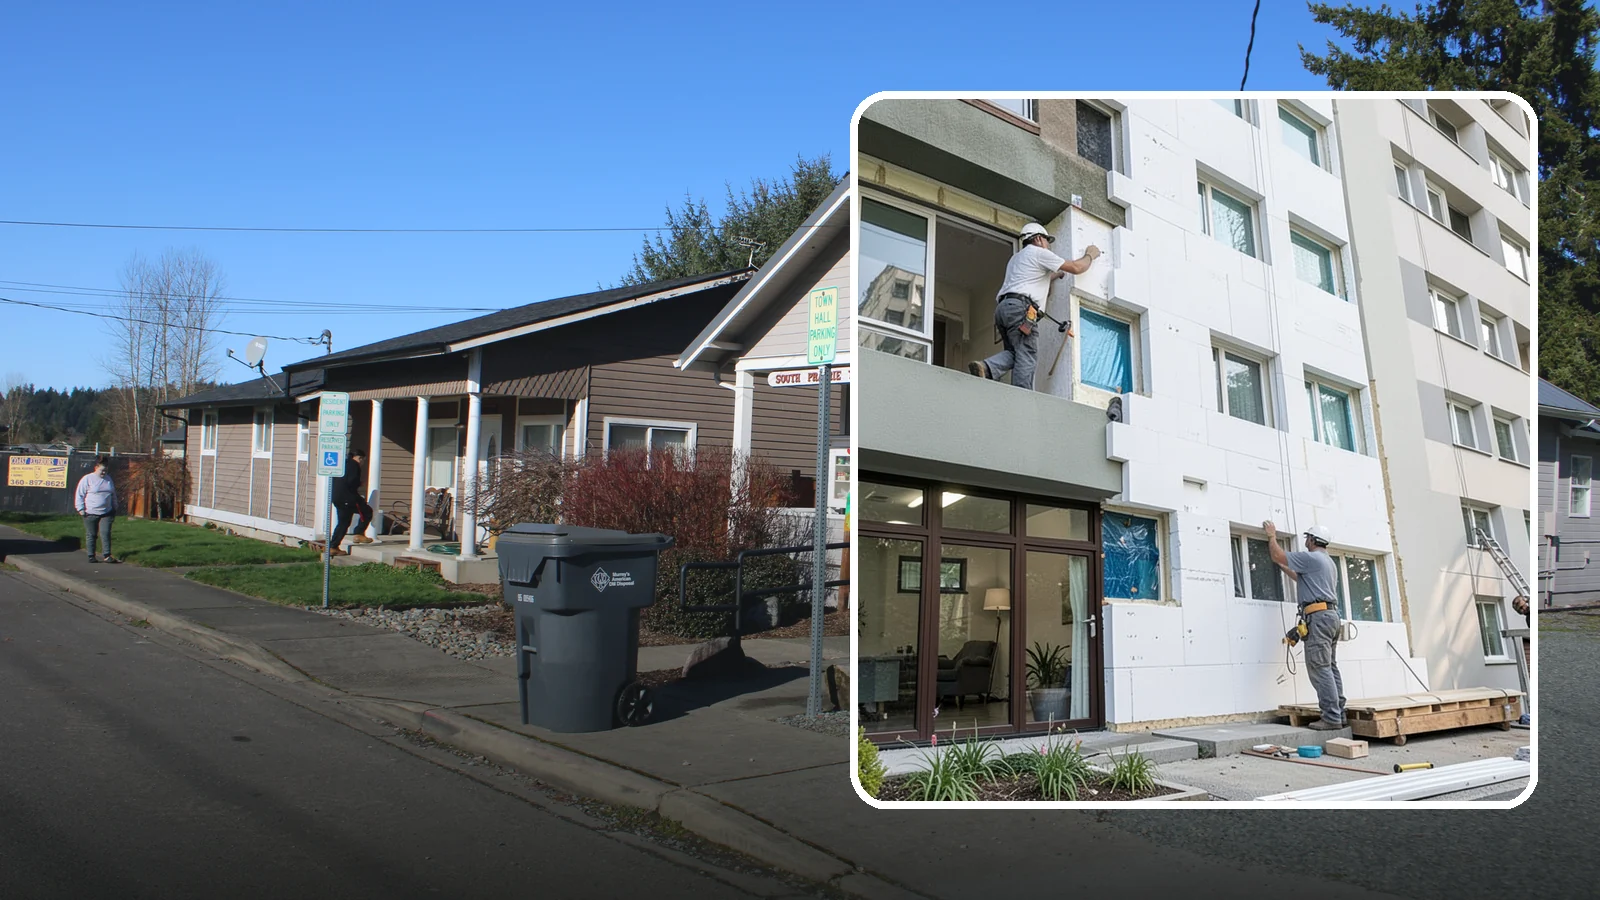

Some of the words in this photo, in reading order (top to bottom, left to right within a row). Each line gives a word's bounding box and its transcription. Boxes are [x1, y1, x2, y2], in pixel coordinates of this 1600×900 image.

[815, 294, 833, 308] TOWN
[814, 311, 831, 324] HALL
[810, 326, 836, 341] PARKING
[813, 344, 831, 357] ONLY
[775, 373, 801, 384] SOUTH
[325, 420, 340, 428] ONLY
